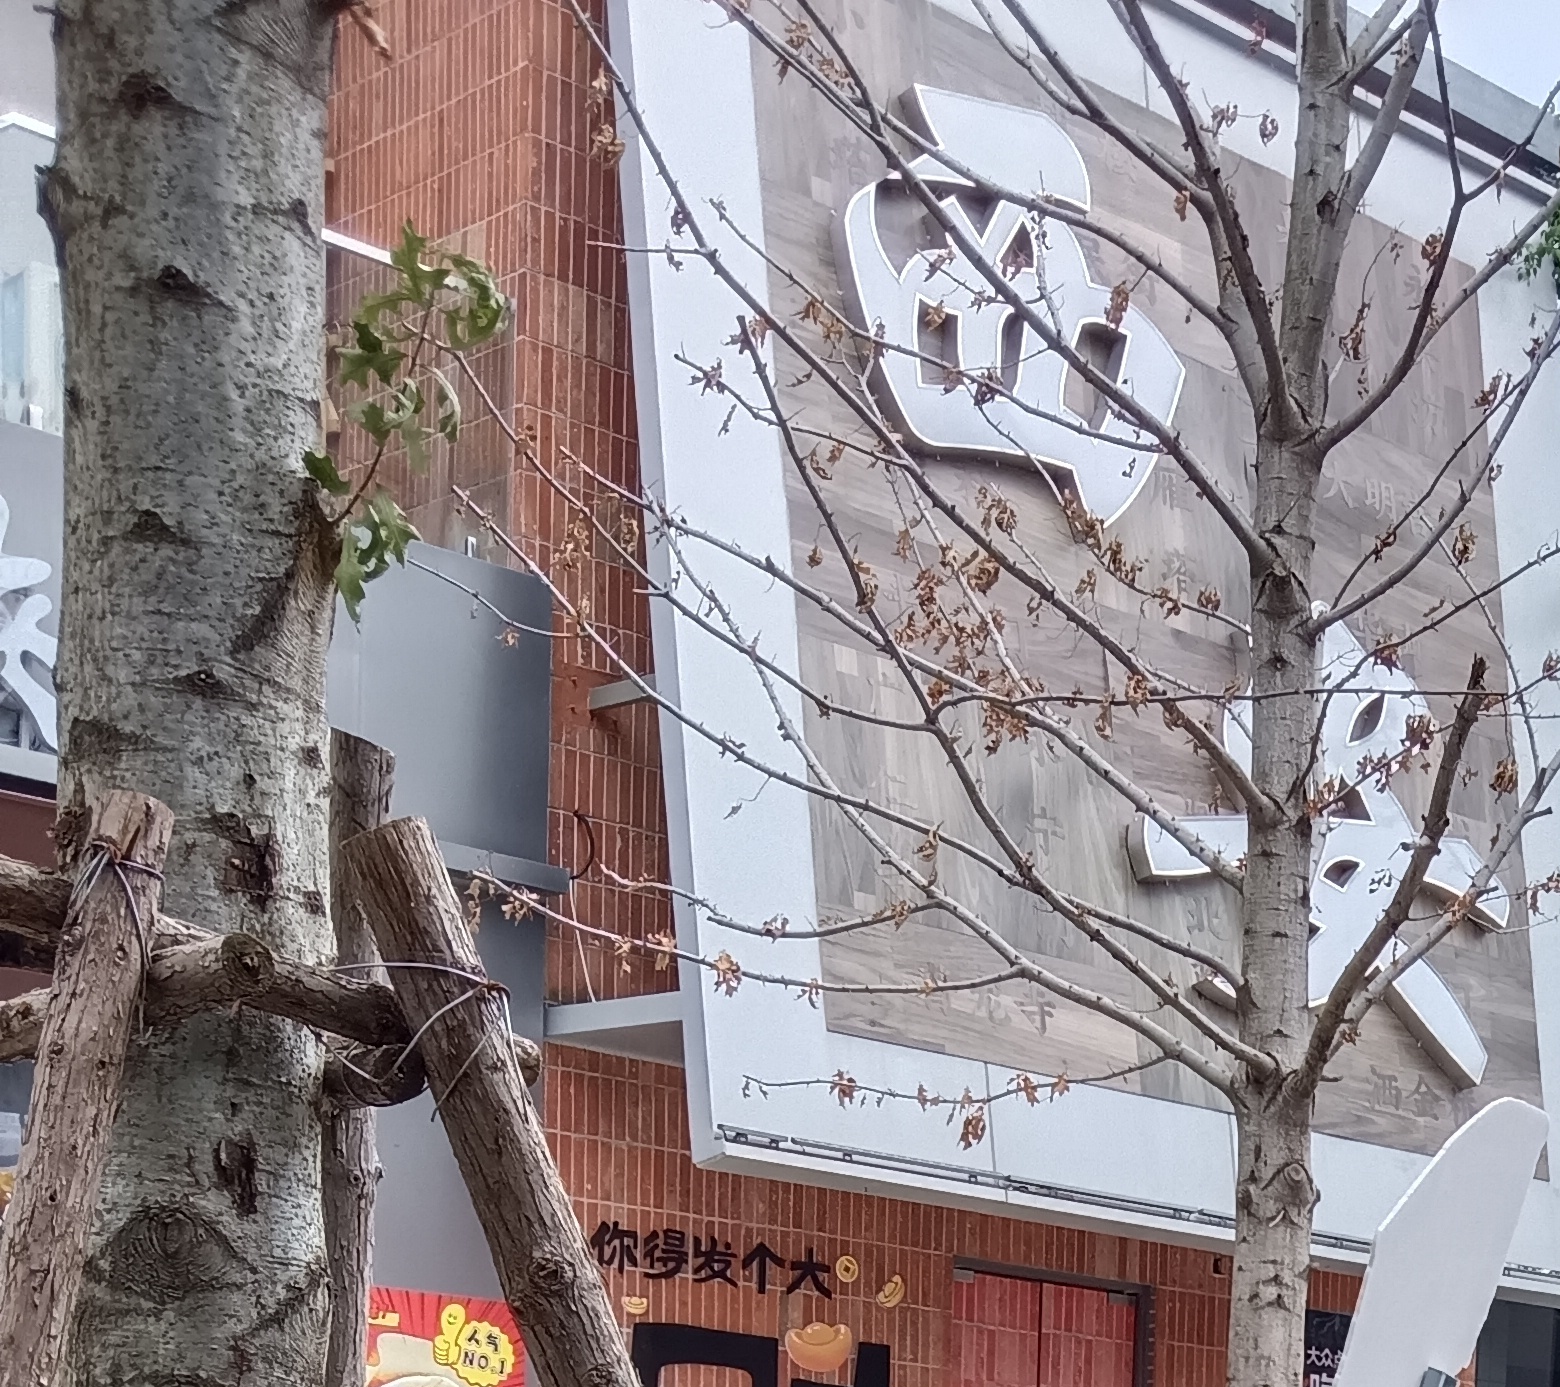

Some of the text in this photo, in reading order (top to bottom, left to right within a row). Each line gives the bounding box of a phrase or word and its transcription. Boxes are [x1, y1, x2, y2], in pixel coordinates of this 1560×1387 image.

[590, 1220, 832, 1300] 你得发个大
[466, 1328, 500, 1354] 人气
